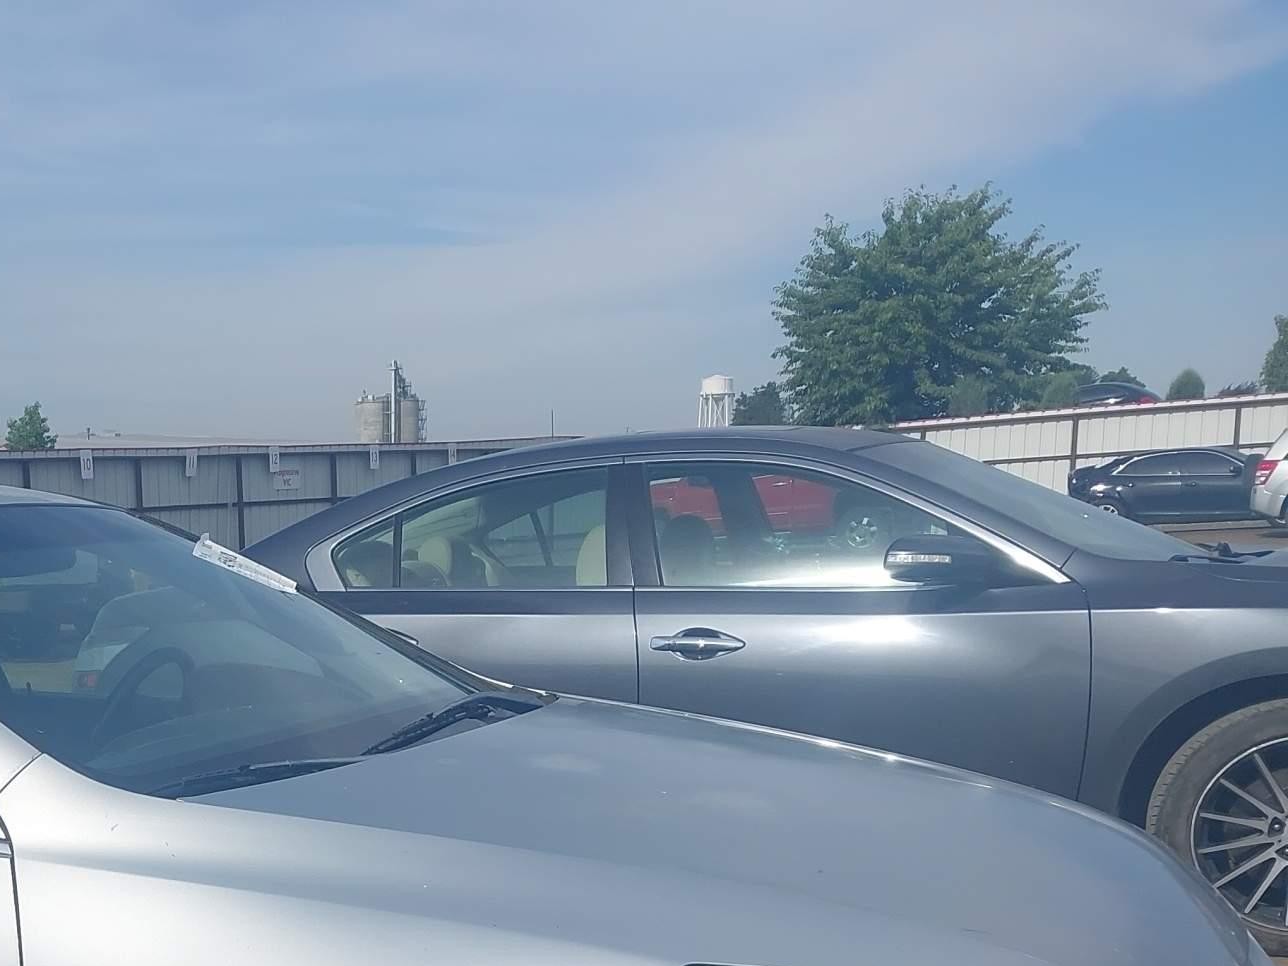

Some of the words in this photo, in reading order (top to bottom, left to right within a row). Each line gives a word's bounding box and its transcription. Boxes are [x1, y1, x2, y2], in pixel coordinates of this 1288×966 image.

[81, 458, 91, 471] 10
[188, 455, 195, 469] 11
[271, 453, 279, 465] 12
